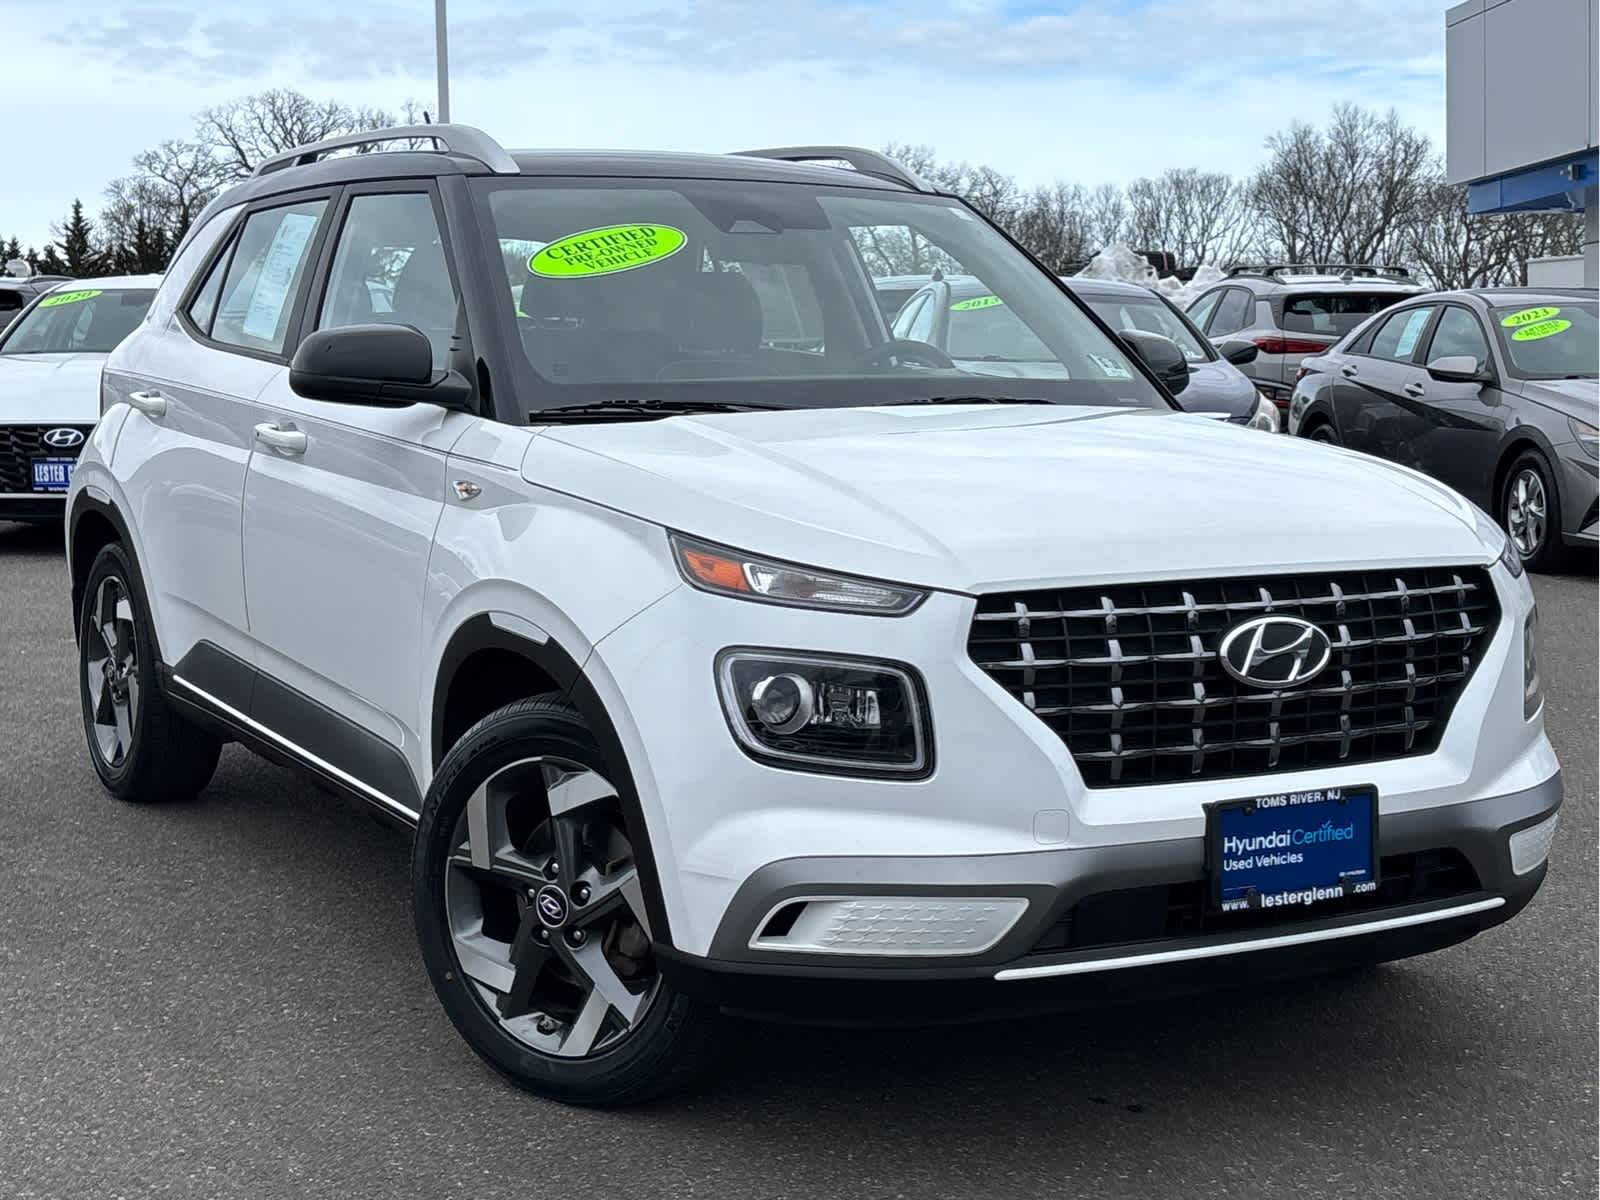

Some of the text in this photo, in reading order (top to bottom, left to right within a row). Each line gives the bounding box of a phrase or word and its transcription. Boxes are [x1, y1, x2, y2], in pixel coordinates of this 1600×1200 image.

[546, 227, 657, 260] CERTIFIED
[563, 238, 658, 266] PRE-OWNED
[583, 248, 653, 270] VEHICLE
[1511, 308, 1550, 324] 2023
[34, 463, 65, 482] LESTER
[1256, 795, 1287, 809] TOMS
[1327, 789, 1341, 800] NJ
[1223, 822, 1353, 855] Hyundai Certified
[1223, 852, 1304, 871] Used Vehicles
[1260, 886, 1343, 909] lesterglenn
